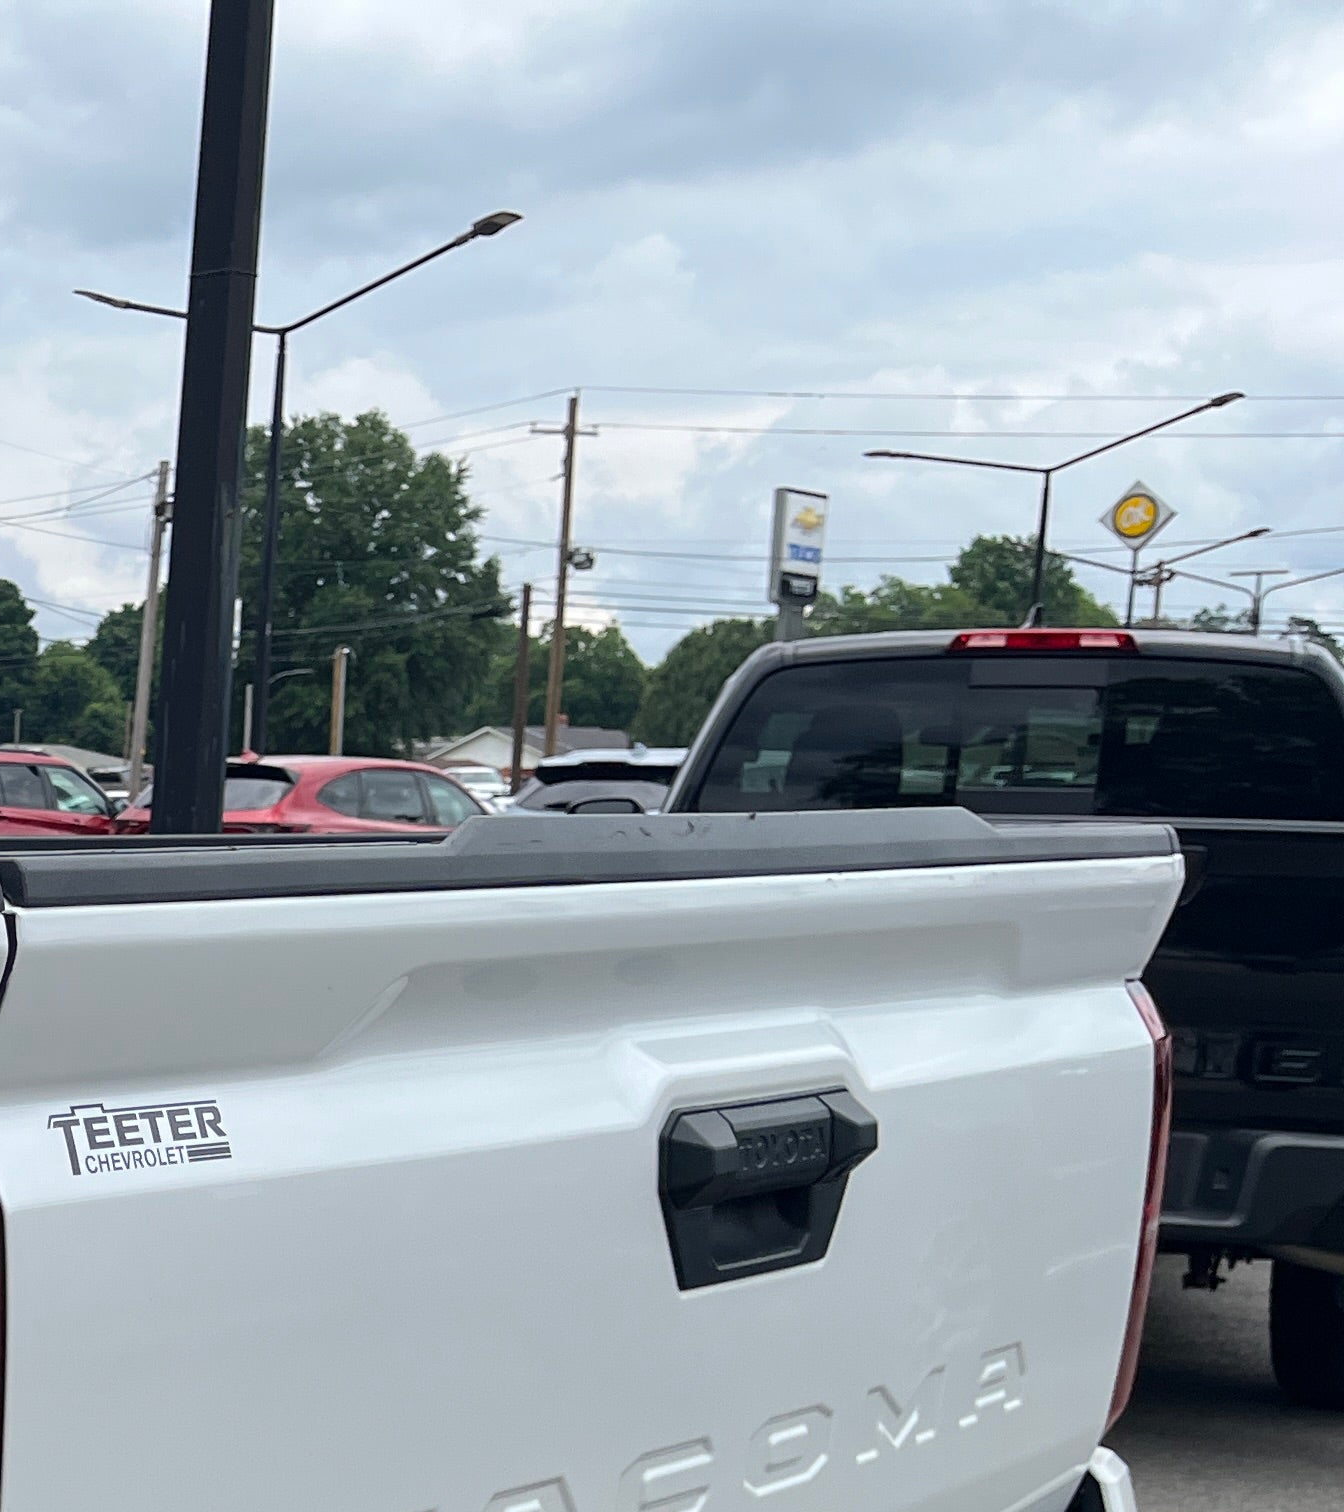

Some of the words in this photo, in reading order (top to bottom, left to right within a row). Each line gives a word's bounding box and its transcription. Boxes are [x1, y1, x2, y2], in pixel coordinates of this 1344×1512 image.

[53, 1104, 228, 1176] TEETER
[85, 1145, 185, 1174] CHEVROLET
[736, 1126, 827, 1172] TOYOTA
